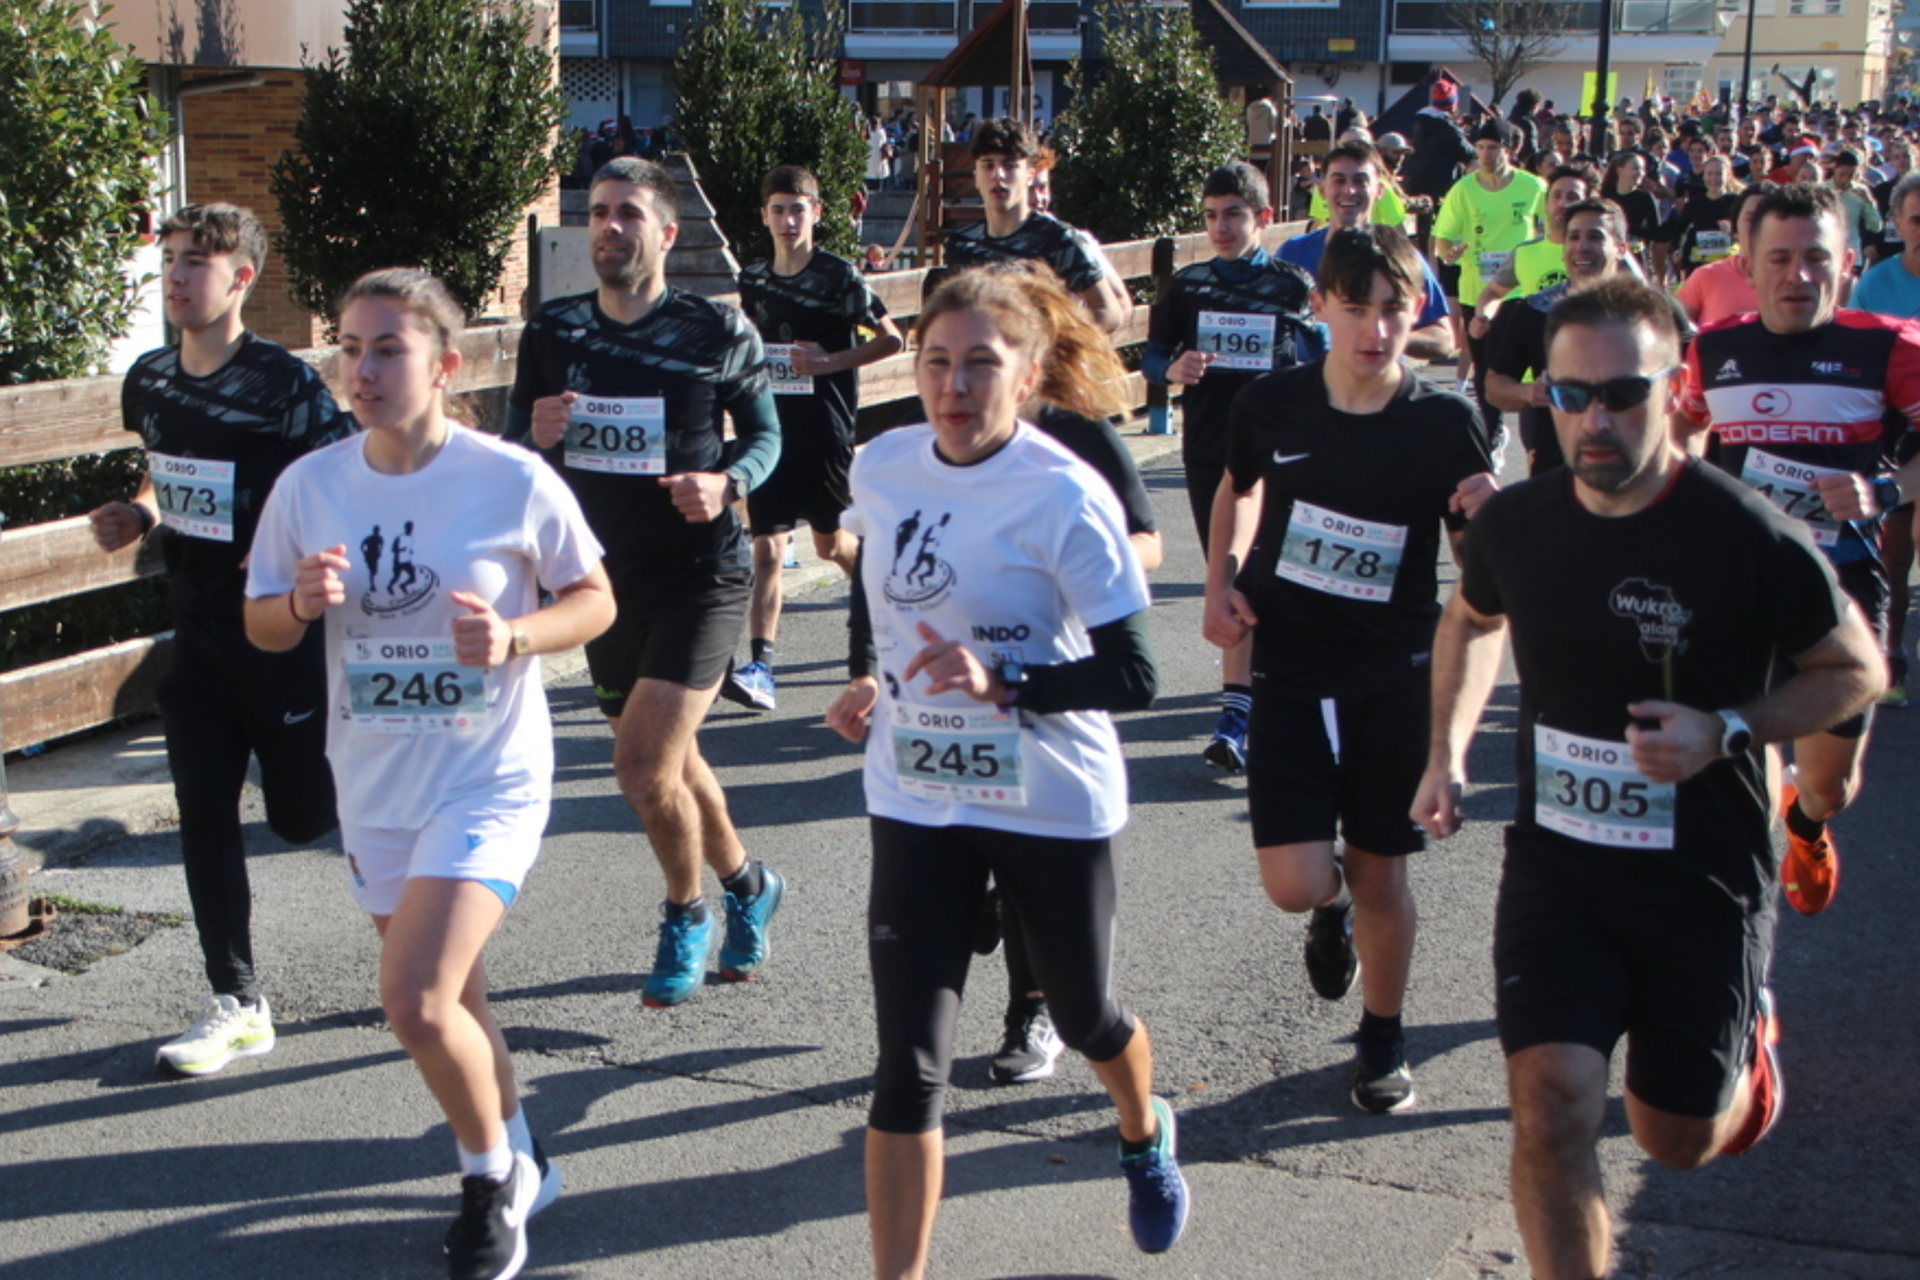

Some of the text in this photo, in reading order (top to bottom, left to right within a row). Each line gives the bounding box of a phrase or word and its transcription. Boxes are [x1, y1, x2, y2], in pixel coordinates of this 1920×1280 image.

[1211, 332, 1261, 354] 196
[586, 402, 624, 415] ORIO
[579, 422, 646, 453] 208
[165, 461, 197, 476] ORIO
[1773, 462, 1816, 482] ORIO
[161, 483, 217, 517] 173
[1322, 516, 1365, 537] ORIO
[1304, 537, 1382, 579] 178
[971, 625, 1030, 643] INDO
[380, 644, 430, 659] ORIO
[371, 671, 463, 707] 246
[918, 712, 966, 730] ORIO
[910, 738, 999, 778] 245
[1566, 743, 1618, 764] ORIO
[1555, 769, 1649, 818] 305
